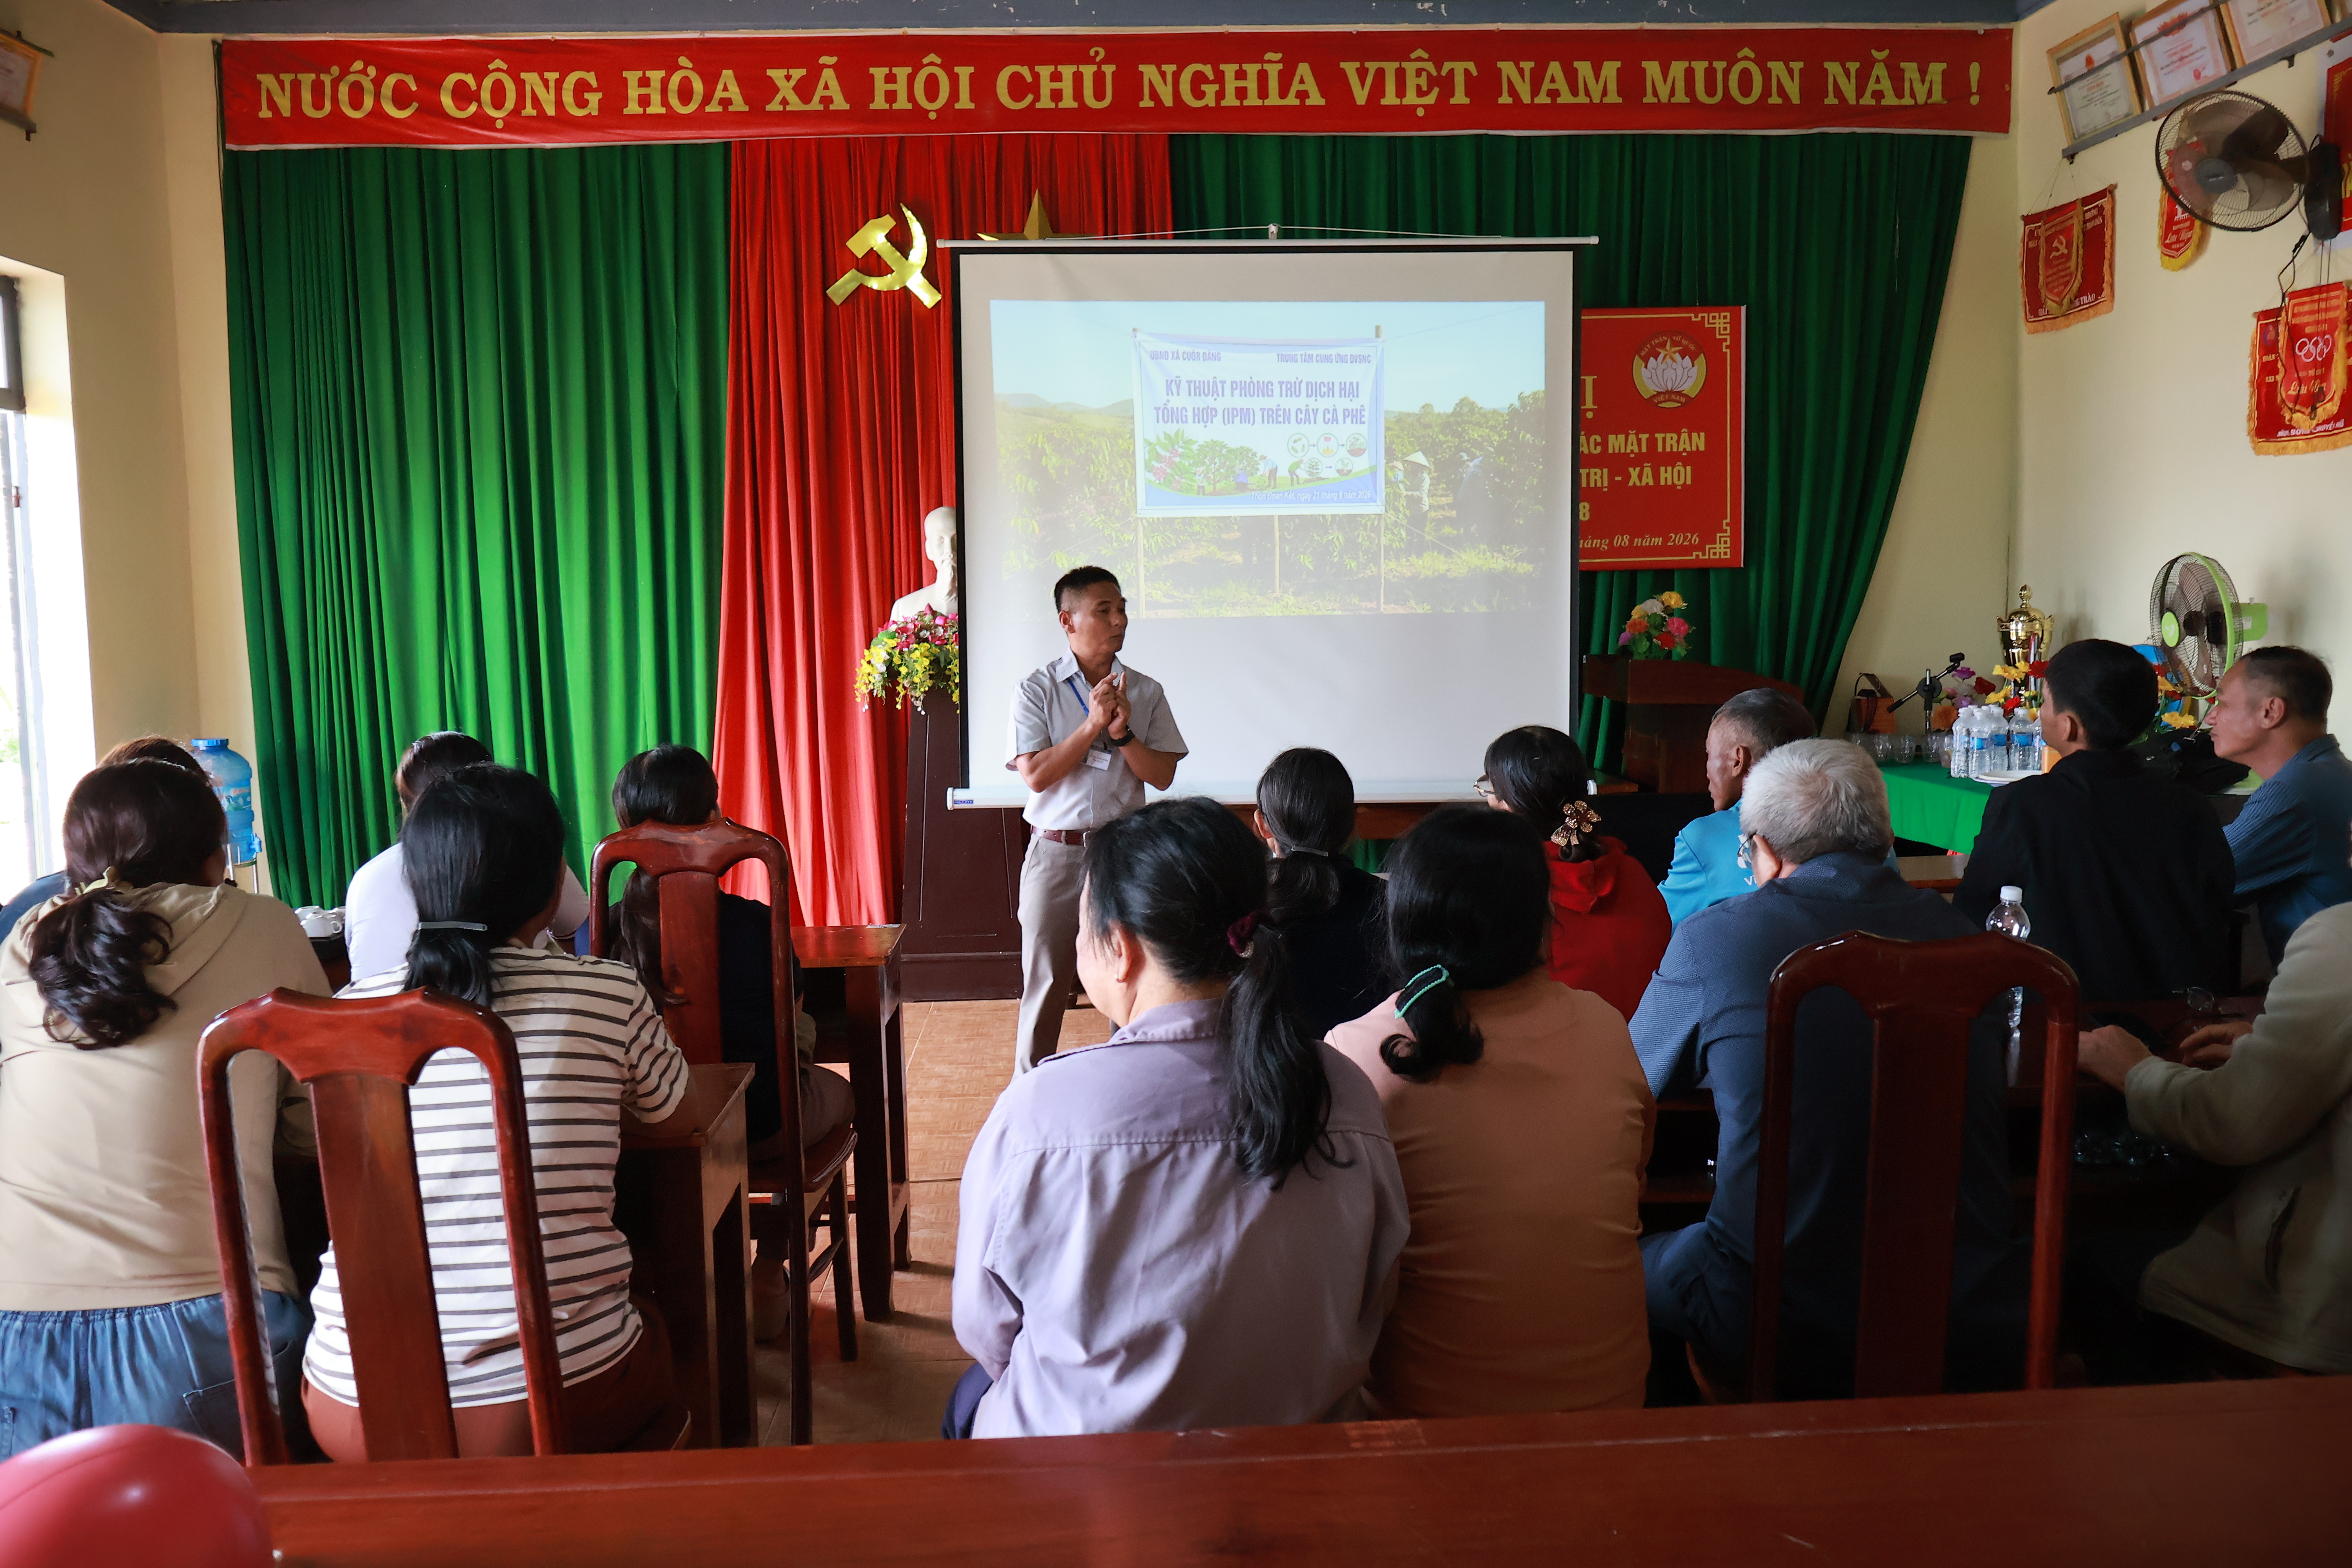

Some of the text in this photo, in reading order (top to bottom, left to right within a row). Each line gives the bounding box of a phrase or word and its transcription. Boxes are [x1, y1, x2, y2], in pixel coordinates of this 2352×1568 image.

[256, 47, 1982, 129] NƯỚC CỘNG HÒA XÃ HỘI CHỦ NGHĨA VIỆT NAM MUÔN NĂM !
[1150, 350, 1169, 360] UBND
[1277, 353, 1298, 363] TRUNG
[1315, 354, 1333, 363] CUNG
[1335, 352, 1348, 363] ỨNG
[1165, 375, 1359, 402] KỸ THUẬT PHÒNG TRỪ DỊCH HẠI
[1154, 399, 1188, 424] TỔNG
[1192, 405, 1218, 428] HỢP
[1222, 407, 1255, 426] (IPM)
[1259, 404, 1291, 425] TRÊN
[1295, 404, 1319, 425] CÂY
[1323, 404, 1339, 425] CÀ
[1608, 430, 1649, 457] MẶT
[1655, 428, 1705, 456] TRẬN
[1580, 468, 1608, 491] TRỊ
[1628, 463, 1654, 486] XÃ
[1660, 462, 1691, 489] HỘI
[1313, 490, 1320, 499] 21
[1344, 490, 1357, 499] năm
[1357, 490, 1372, 499] 2026
[1613, 535, 1630, 547] 08
[1634, 535, 1662, 546] năm
[1667, 533, 1699, 546] 2026
